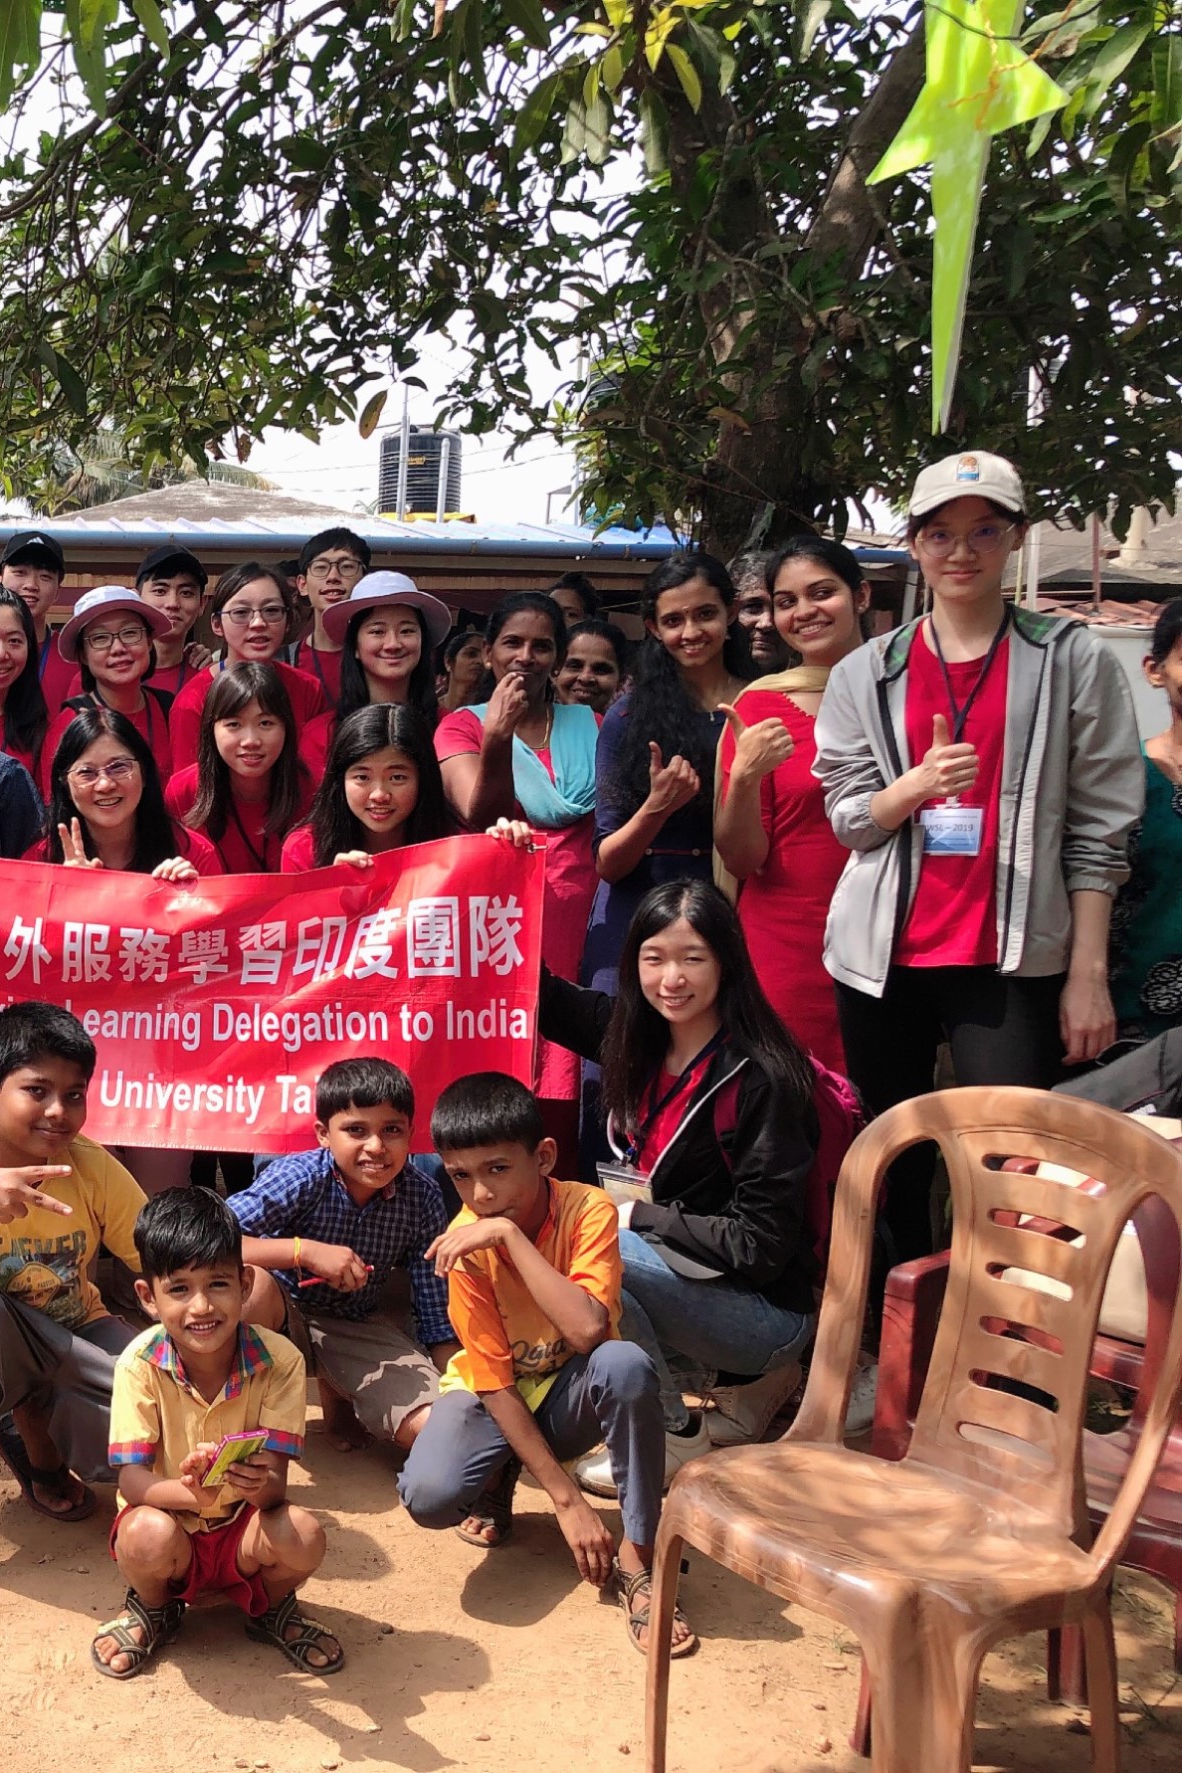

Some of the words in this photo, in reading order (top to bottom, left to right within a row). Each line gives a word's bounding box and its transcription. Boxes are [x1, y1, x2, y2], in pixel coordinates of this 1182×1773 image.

[65, 999, 201, 1051] earning
[212, 1003, 388, 1052] Delegation
[400, 1003, 433, 1042] to
[446, 998, 528, 1041] India
[100, 1069, 265, 1125] University
